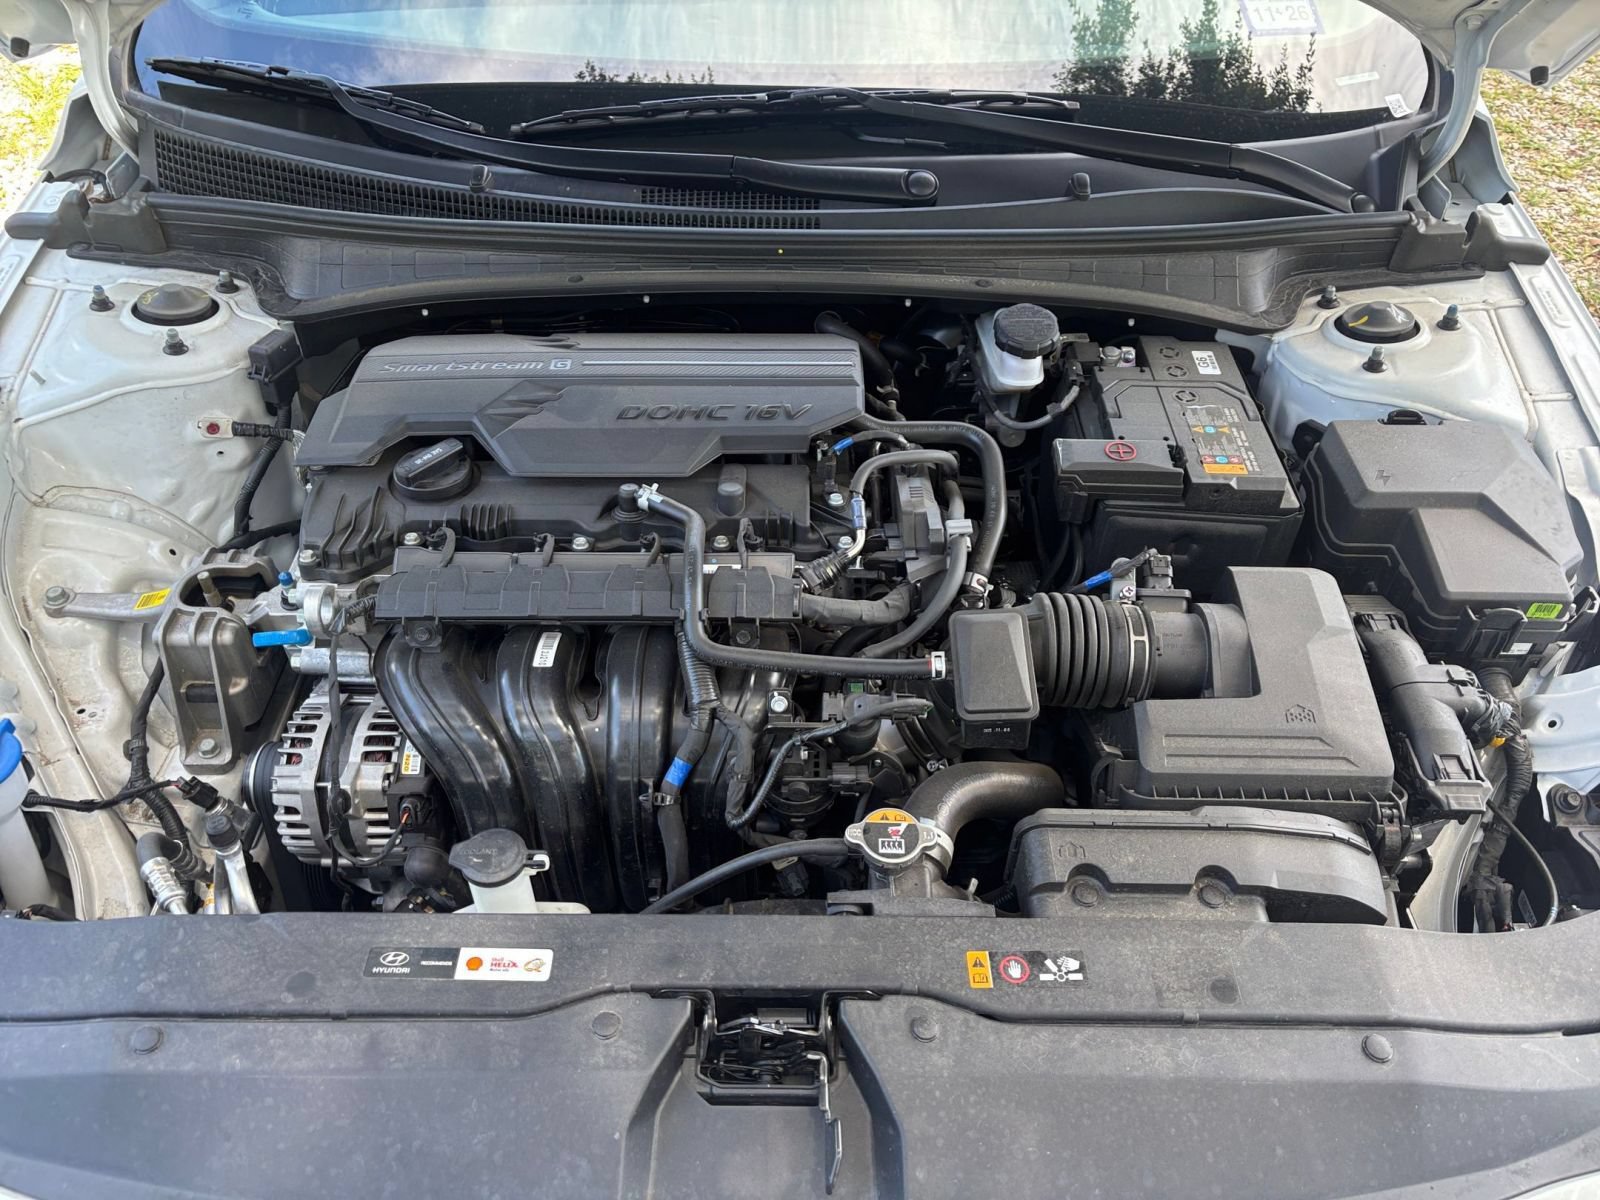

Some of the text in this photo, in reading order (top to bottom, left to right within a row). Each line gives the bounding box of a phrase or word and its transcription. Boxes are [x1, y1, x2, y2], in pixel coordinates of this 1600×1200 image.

[380, 360, 544, 373] Smartstream
[1195, 356, 1210, 368] G6
[616, 403, 813, 421] DOHC 16V
[490, 960, 518, 968] HELIX
